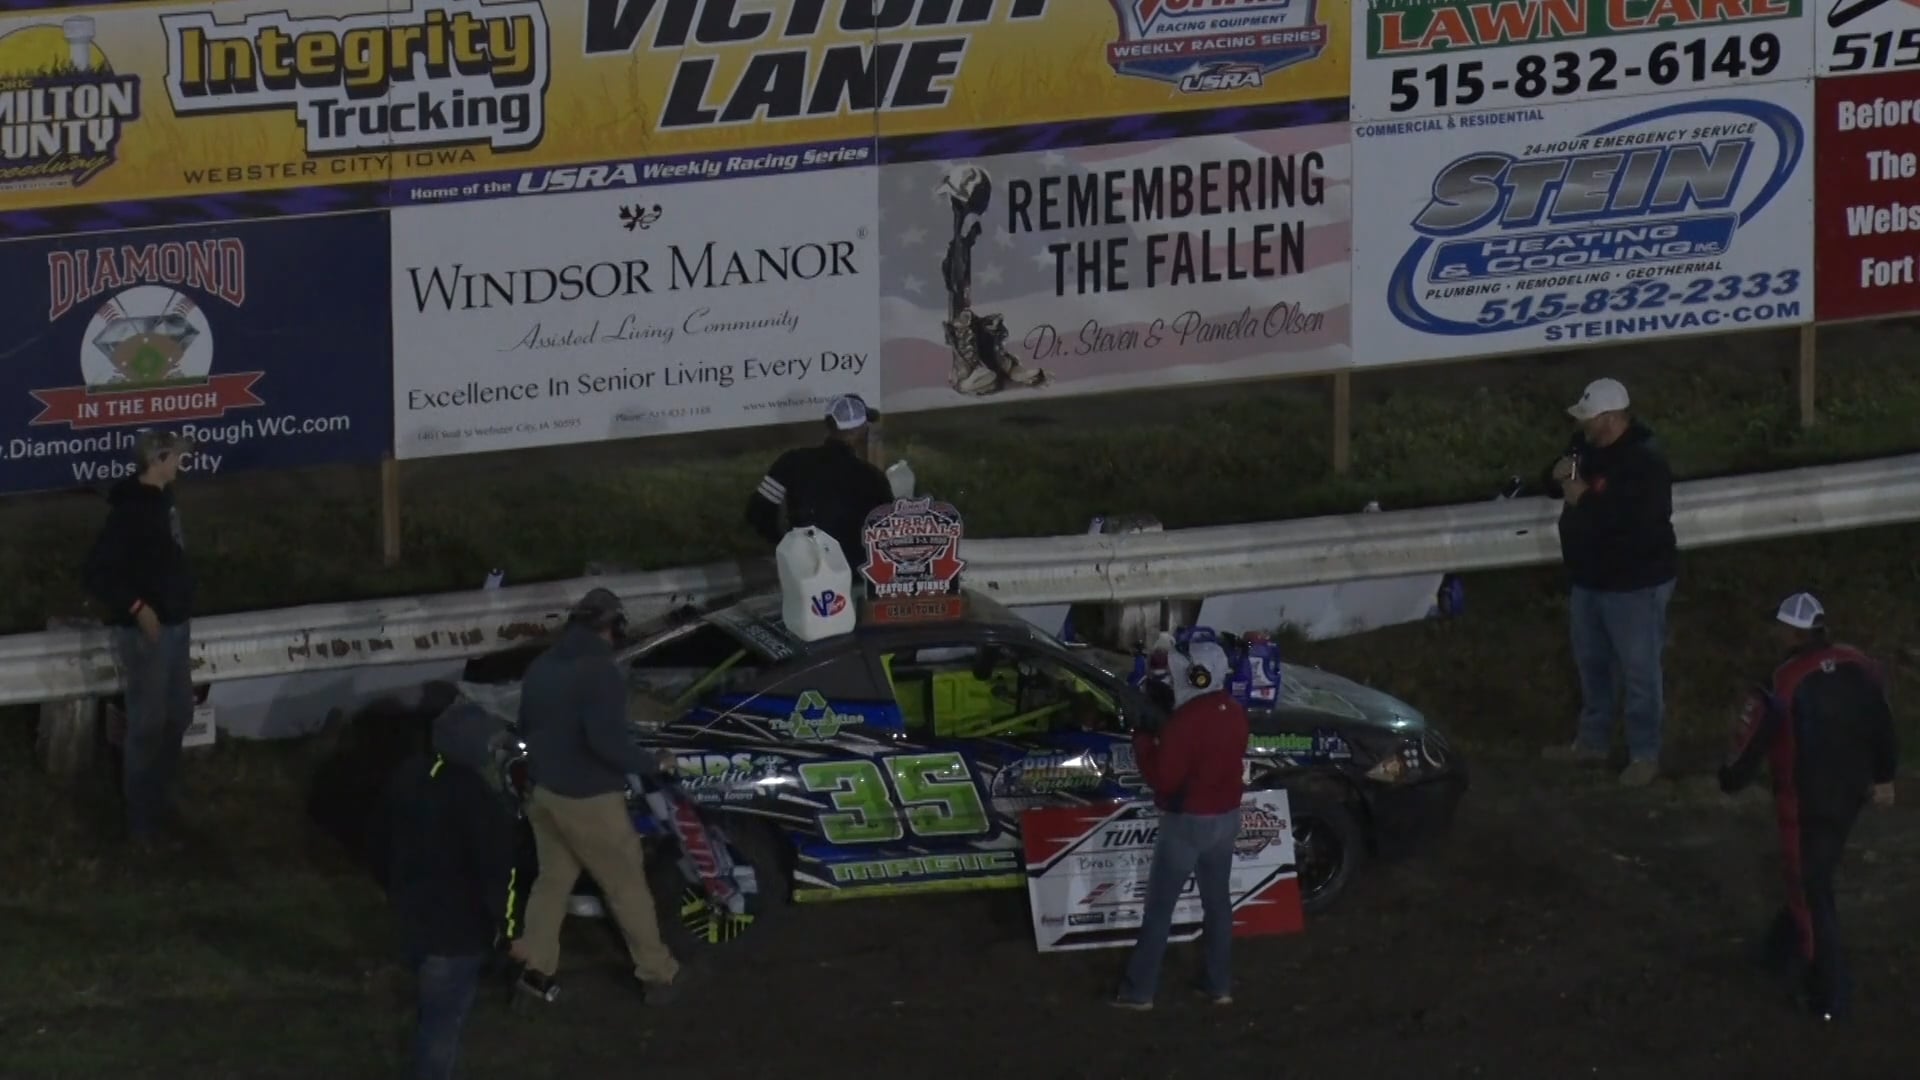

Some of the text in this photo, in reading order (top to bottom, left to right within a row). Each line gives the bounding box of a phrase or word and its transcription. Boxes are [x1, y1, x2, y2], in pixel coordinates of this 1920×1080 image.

[584, 0, 1049, 53] VICTO
[1113, 29, 1321, 58] WEEKLY RACING SERIES
[1156, 21, 1206, 34] RACING
[1210, 13, 1287, 29] EQUIPMENT
[1377, 0, 1588, 54] LAWN
[179, 9, 535, 98] Integrity
[1390, 32, 1781, 113] 515-832-6149
[660, 37, 966, 128] LANE
[1181, 70, 1263, 92] USRA
[309, 89, 531, 138] Trucking
[1356, 109, 1545, 138] COMMERCIAL & RESIDENTIAL
[1, 117, 115, 160] UNTY
[1524, 122, 1757, 156] 24-HOUR EMERGENCY SERVICE
[184, 161, 317, 184] WEBSTER
[406, 149, 476, 167] IOWA
[411, 146, 869, 200] Home of the USRA Weekly Racing Series
[1412, 137, 1753, 236] STEIN
[1866, 150, 1917, 181] The
[1008, 152, 1325, 233] REMEMBERING
[1481, 224, 1680, 256] HEATING
[1846, 202, 1920, 237] Webs
[48, 237, 246, 322] DIAMOND
[407, 241, 858, 313] WINDSOR MANOR
[1048, 221, 1305, 296] THE FALLEN
[1426, 260, 1723, 300] PLUMBING REMODELING GEOTHERMAL
[1438, 261, 1471, 279] &
[1486, 242, 1690, 274] COOLING
[1861, 255, 1914, 288] Fort
[1477, 269, 1800, 325] 515-832-2333
[497, 307, 799, 351] Assisted Living Community
[1023, 301, 1325, 360] Dr. Steven & Pamela Olsen
[408, 350, 868, 411] Excellence In Senior Living Every Day
[77, 391, 218, 419] IN THE ROUGH
[72, 452, 222, 480] Webs City
[799, 751, 990, 844] 35
[1102, 827, 1158, 848] TUNE
[828, 851, 1019, 883] MAGIC
